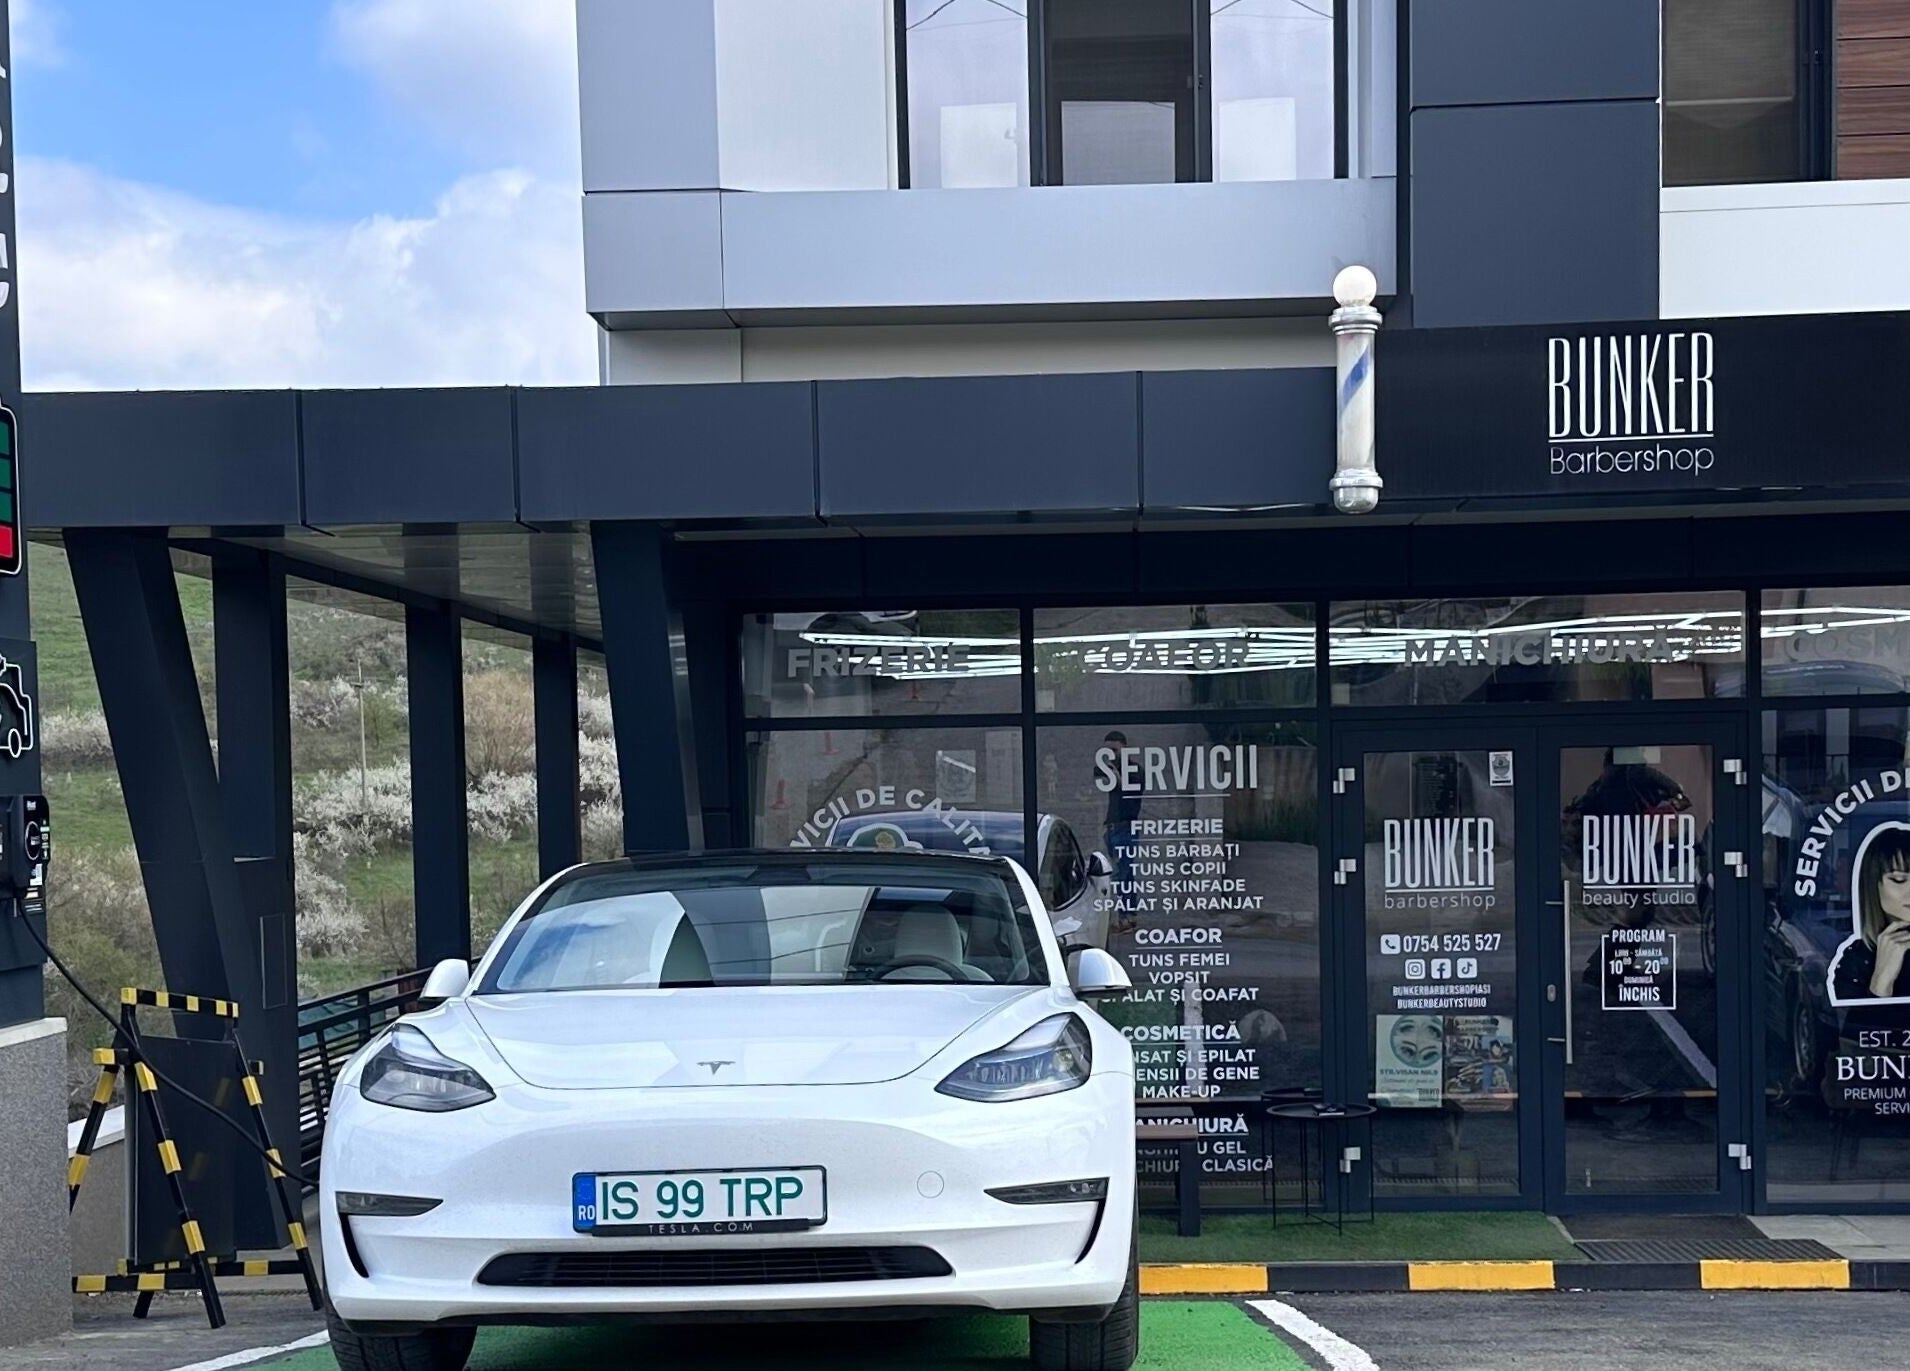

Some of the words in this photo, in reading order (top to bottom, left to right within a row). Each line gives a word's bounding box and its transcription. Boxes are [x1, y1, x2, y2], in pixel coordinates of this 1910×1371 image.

[1549, 332, 1714, 437] BUNKER
[1550, 443, 1715, 476] Barbershop
[788, 645, 970, 677] FRIZERIE
[1077, 640, 1251, 672] COAFOR
[1095, 744, 1257, 792] SERVICII
[856, 786, 895, 809] DE
[1131, 818, 1223, 835] FRIZERIE
[1794, 779, 1874, 897] SERVICII
[1115, 846, 1160, 858] TUNS
[1166, 843, 1239, 860] BĂRBAȚI
[1384, 817, 1494, 888] BUNKER
[1583, 814, 1695, 884] BUNKER
[1129, 863, 1174, 875] TUNS
[1180, 862, 1226, 874] COPII
[1110, 881, 1155, 894] TUNS
[1161, 879, 1245, 892] SKINFADE
[1093, 897, 1157, 911] SPĂLAT
[1162, 898, 1178, 914] ȘI
[1184, 896, 1263, 909] ARANJAT
[1384, 892, 1496, 910] barbershop
[1582, 891, 1638, 909] beauty
[1643, 889, 1695, 905] studio
[1135, 928, 1222, 943] COAFOR
[1403, 935, 1439, 952] 0754
[1443, 934, 1470, 952] 525
[1475, 933, 1501, 951] 527
[1612, 929, 1665, 942] PROGRAM
[1129, 954, 1174, 966] TUNS
[1179, 953, 1230, 966] FEMEI
[1149, 971, 1210, 984] VOPSIT
[1170, 988, 1185, 1006] ȘI
[1191, 988, 1259, 1001] COAFAT
[1120, 1021, 1241, 1041] COSMETICĂ
[1859, 1031, 1896, 1048] EST.
[1176, 1050, 1192, 1066] ȘI
[1198, 1049, 1256, 1062] EPILAT
[1185, 1068, 1207, 1080] DE
[1213, 1067, 1260, 1080] GENE
[1836, 1055, 1910, 1081] BUN
[1142, 1085, 1221, 1098] MAKE-UP
[1844, 1087, 1906, 1100] PREMIUM
[1213, 1141, 1247, 1154] GEL
[1202, 1155, 1273, 1172] CLASICĂ
[578, 1205, 595, 1220] RO
[602, 1181, 639, 1220] IS
[657, 1180, 704, 1219] 99
[720, 1177, 803, 1217] TRP
